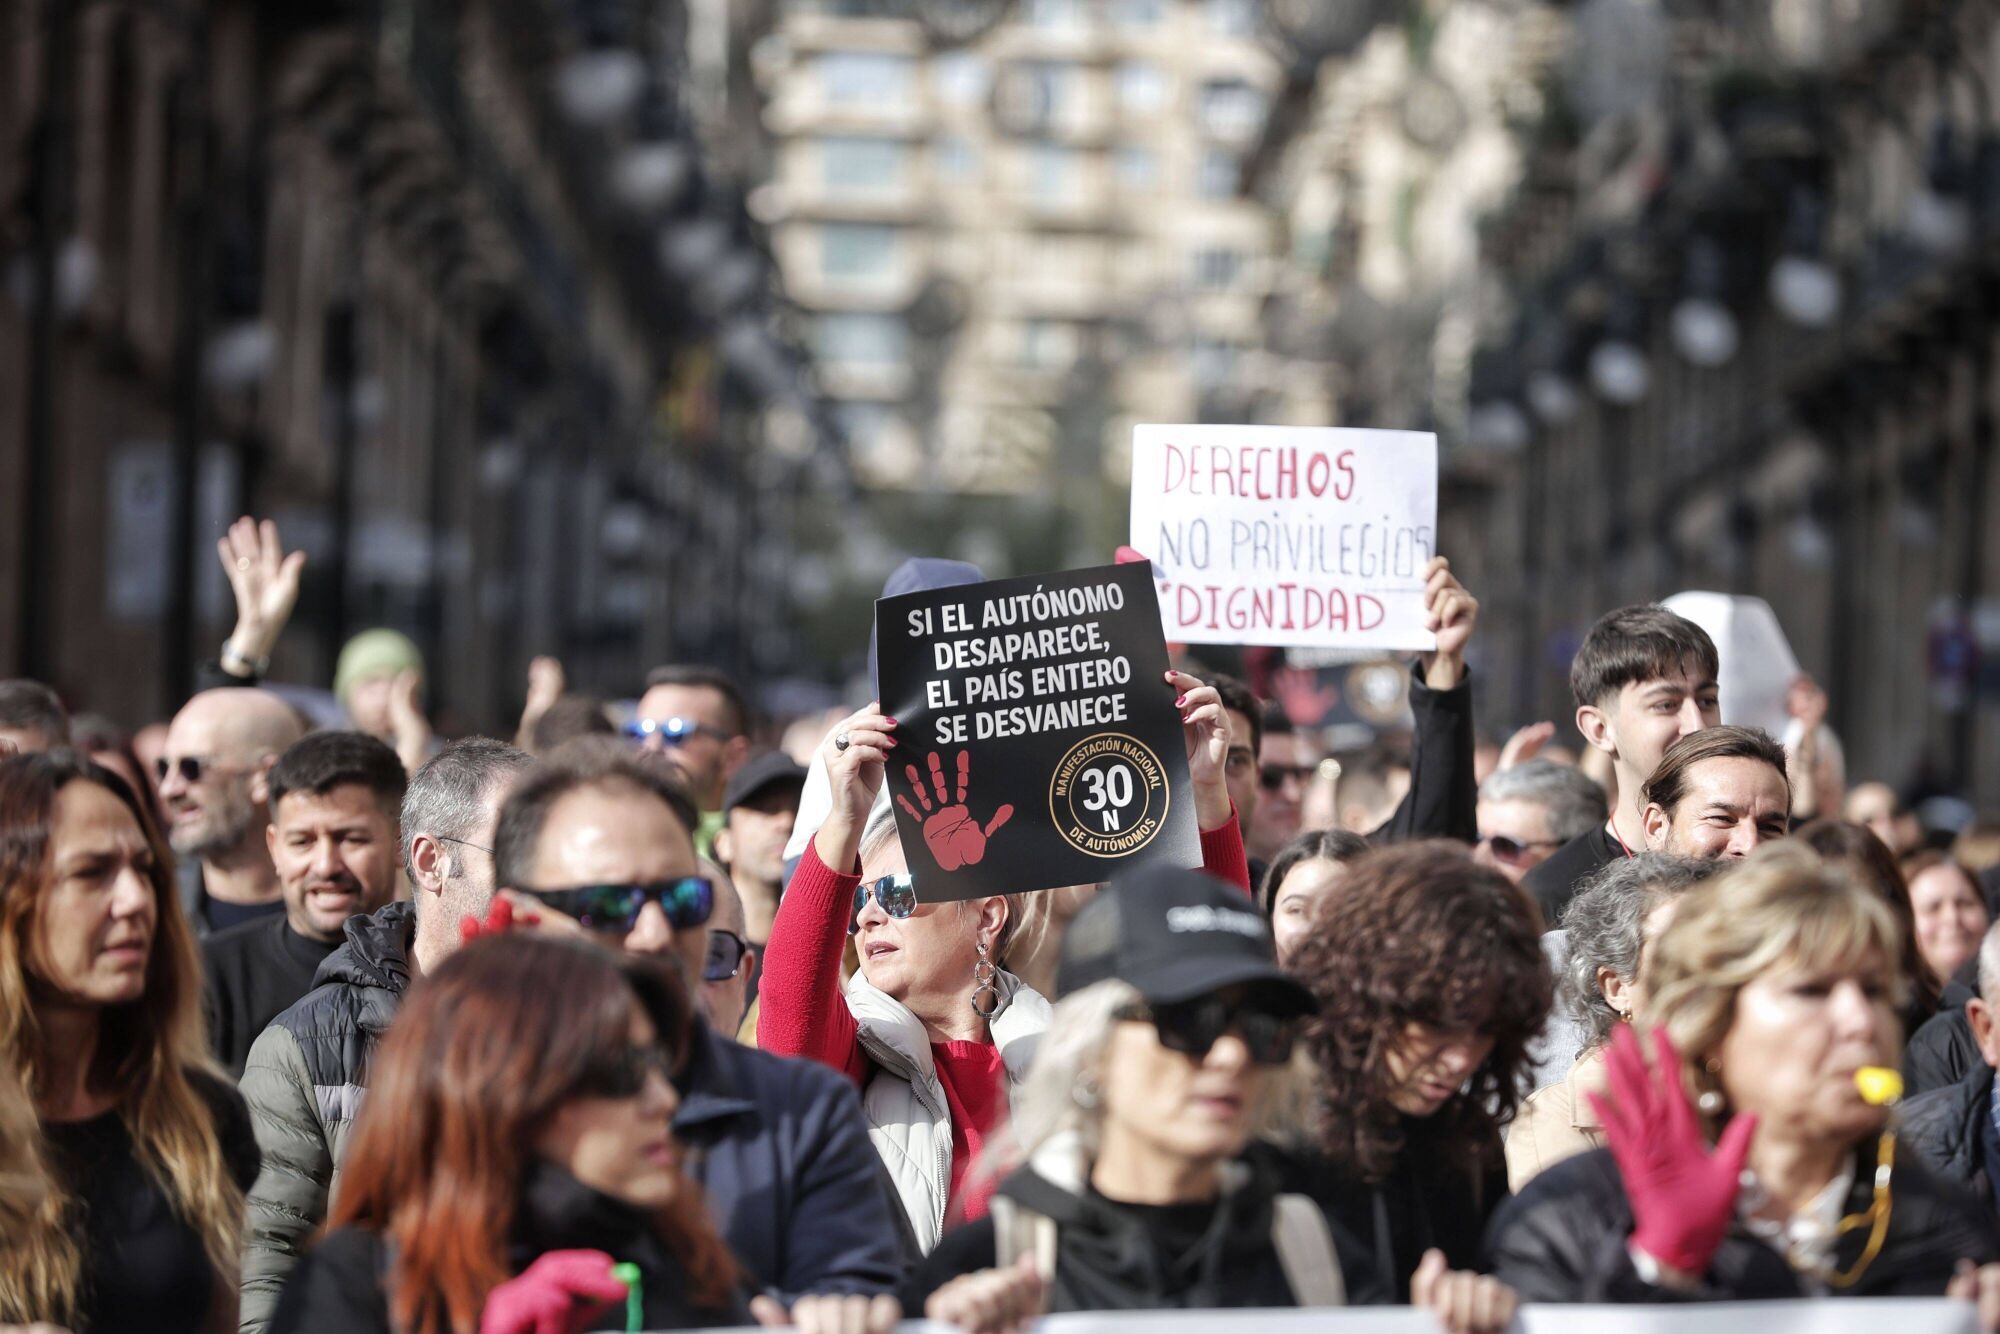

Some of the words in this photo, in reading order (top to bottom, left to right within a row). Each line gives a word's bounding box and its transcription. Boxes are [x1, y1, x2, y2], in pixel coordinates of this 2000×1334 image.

[1163, 443, 1355, 501] DERECHOS
[1158, 517, 1209, 570] NO
[907, 609, 933, 637] SI
[941, 603, 974, 633] EL
[982, 583, 1124, 628] AUTÓNOMO
[934, 622, 1110, 671] DESAPARECE,
[926, 680, 959, 710] EL
[966, 667, 1025, 704] PAÍS
[1033, 655, 1131, 696] ENTERO
[935, 714, 968, 744] SE
[976, 693, 1128, 740] DESVANECE
[1056, 737, 1121, 796] MANIFESTACIÓN
[1122, 742, 1161, 790] NACIONAL
[1081, 764, 1133, 811] 30
[1069, 826, 1087, 843] DE
[1085, 817, 1156, 852] AUTÓNOMOS
[1102, 809, 1120, 832] N
